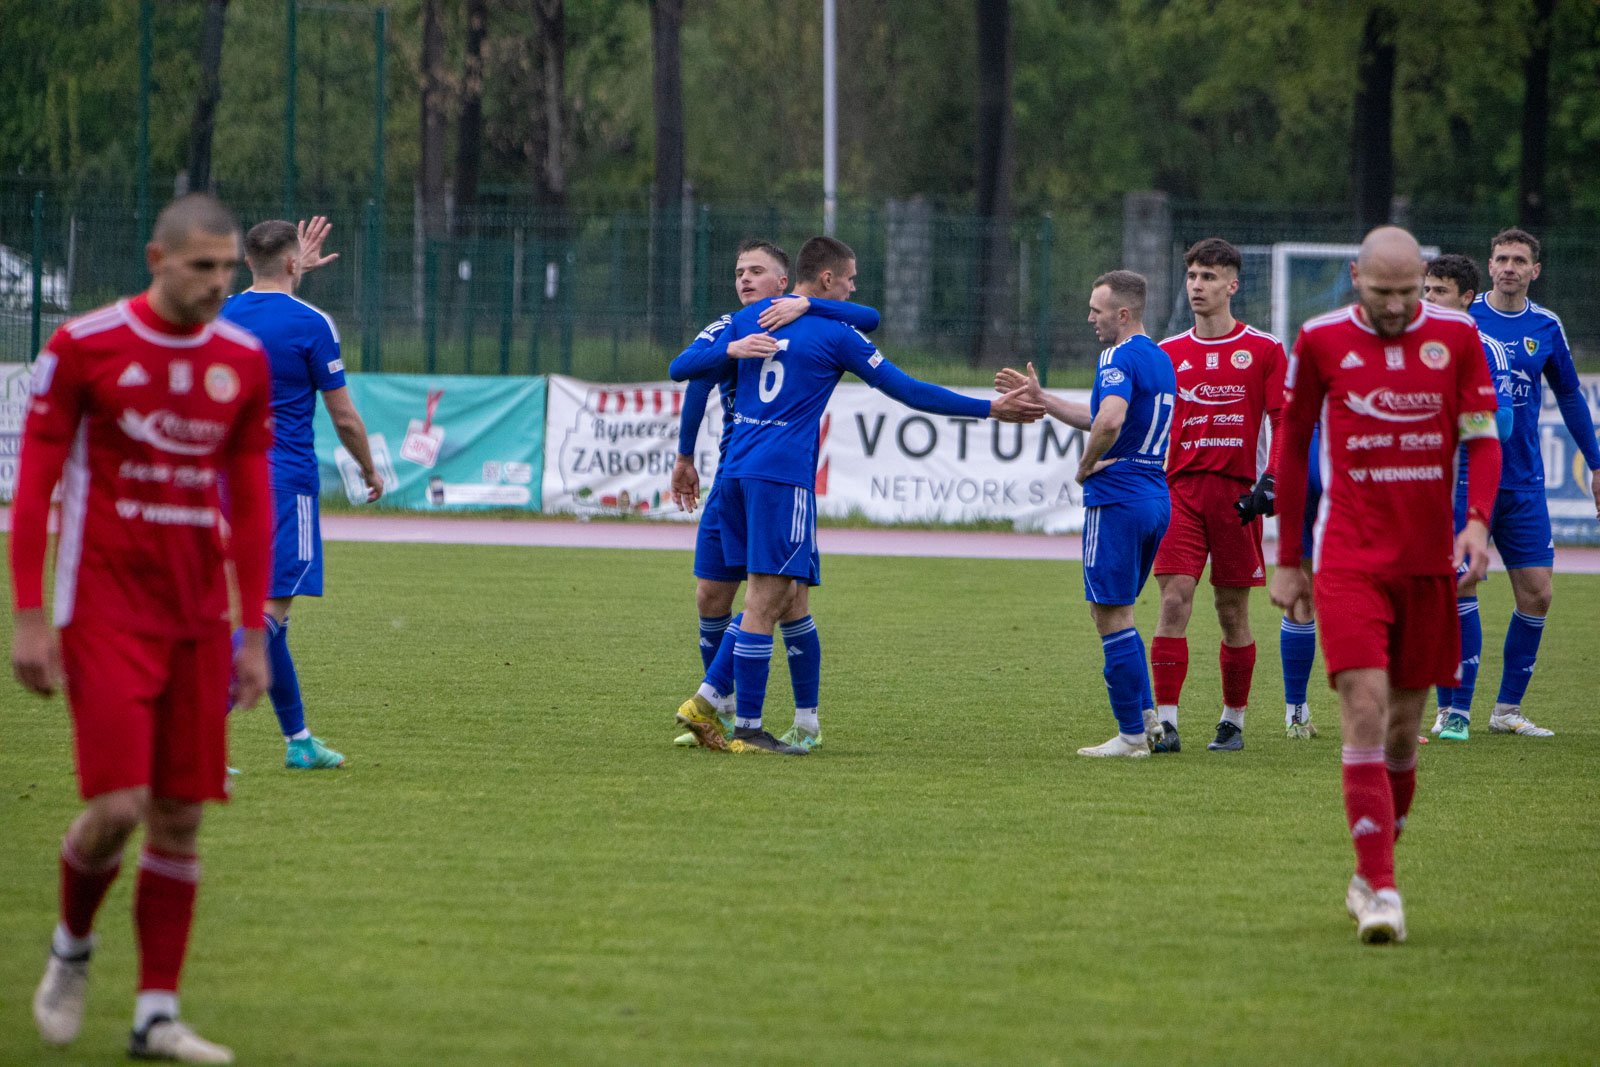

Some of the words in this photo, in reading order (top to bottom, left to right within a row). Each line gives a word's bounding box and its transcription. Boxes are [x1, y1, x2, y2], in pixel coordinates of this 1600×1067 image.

[759, 338, 790, 404] 6
[593, 418, 679, 445] Rynecze
[855, 411, 1085, 463] VOTUM
[1137, 391, 1174, 456] 17
[572, 447, 712, 478] ZABOBRE
[1369, 465, 1443, 482] WENINGER
[870, 475, 1017, 504] NETWORK
